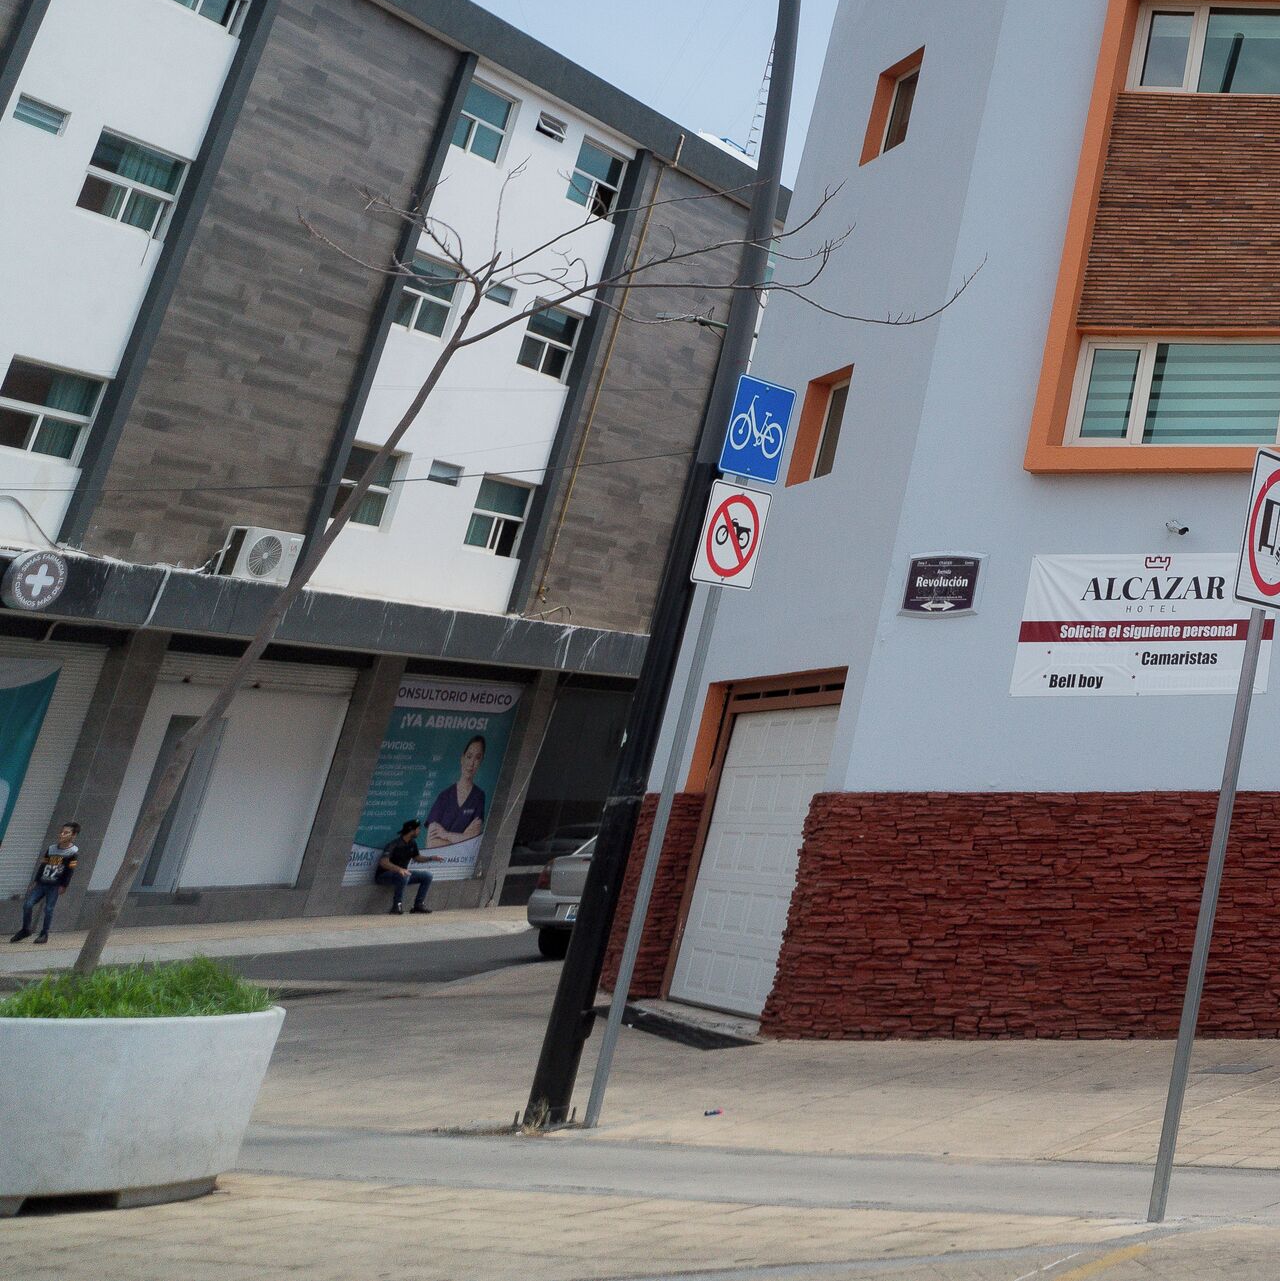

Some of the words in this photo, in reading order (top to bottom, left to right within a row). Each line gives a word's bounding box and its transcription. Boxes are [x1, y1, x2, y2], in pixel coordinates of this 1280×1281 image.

[42, 554, 64, 576] FARMACIA
[916, 576, 968, 587] Revolución
[1080, 576, 1226, 601] ALCAZAR
[1125, 605, 1177, 613] HOTEL
[1060, 624, 1106, 639] Solicita
[1108, 624, 1121, 638] el
[1122, 624, 1181, 640] siguiente
[1182, 623, 1237, 639] personal
[1141, 651, 1218, 666] Camaristas
[1049, 674, 1076, 688] Bell
[1078, 673, 1104, 689] boy
[398, 686, 468, 703] ONSULTORIO
[470, 691, 513, 707] MÉDICO
[425, 715, 489, 731] ABRIMOS!
